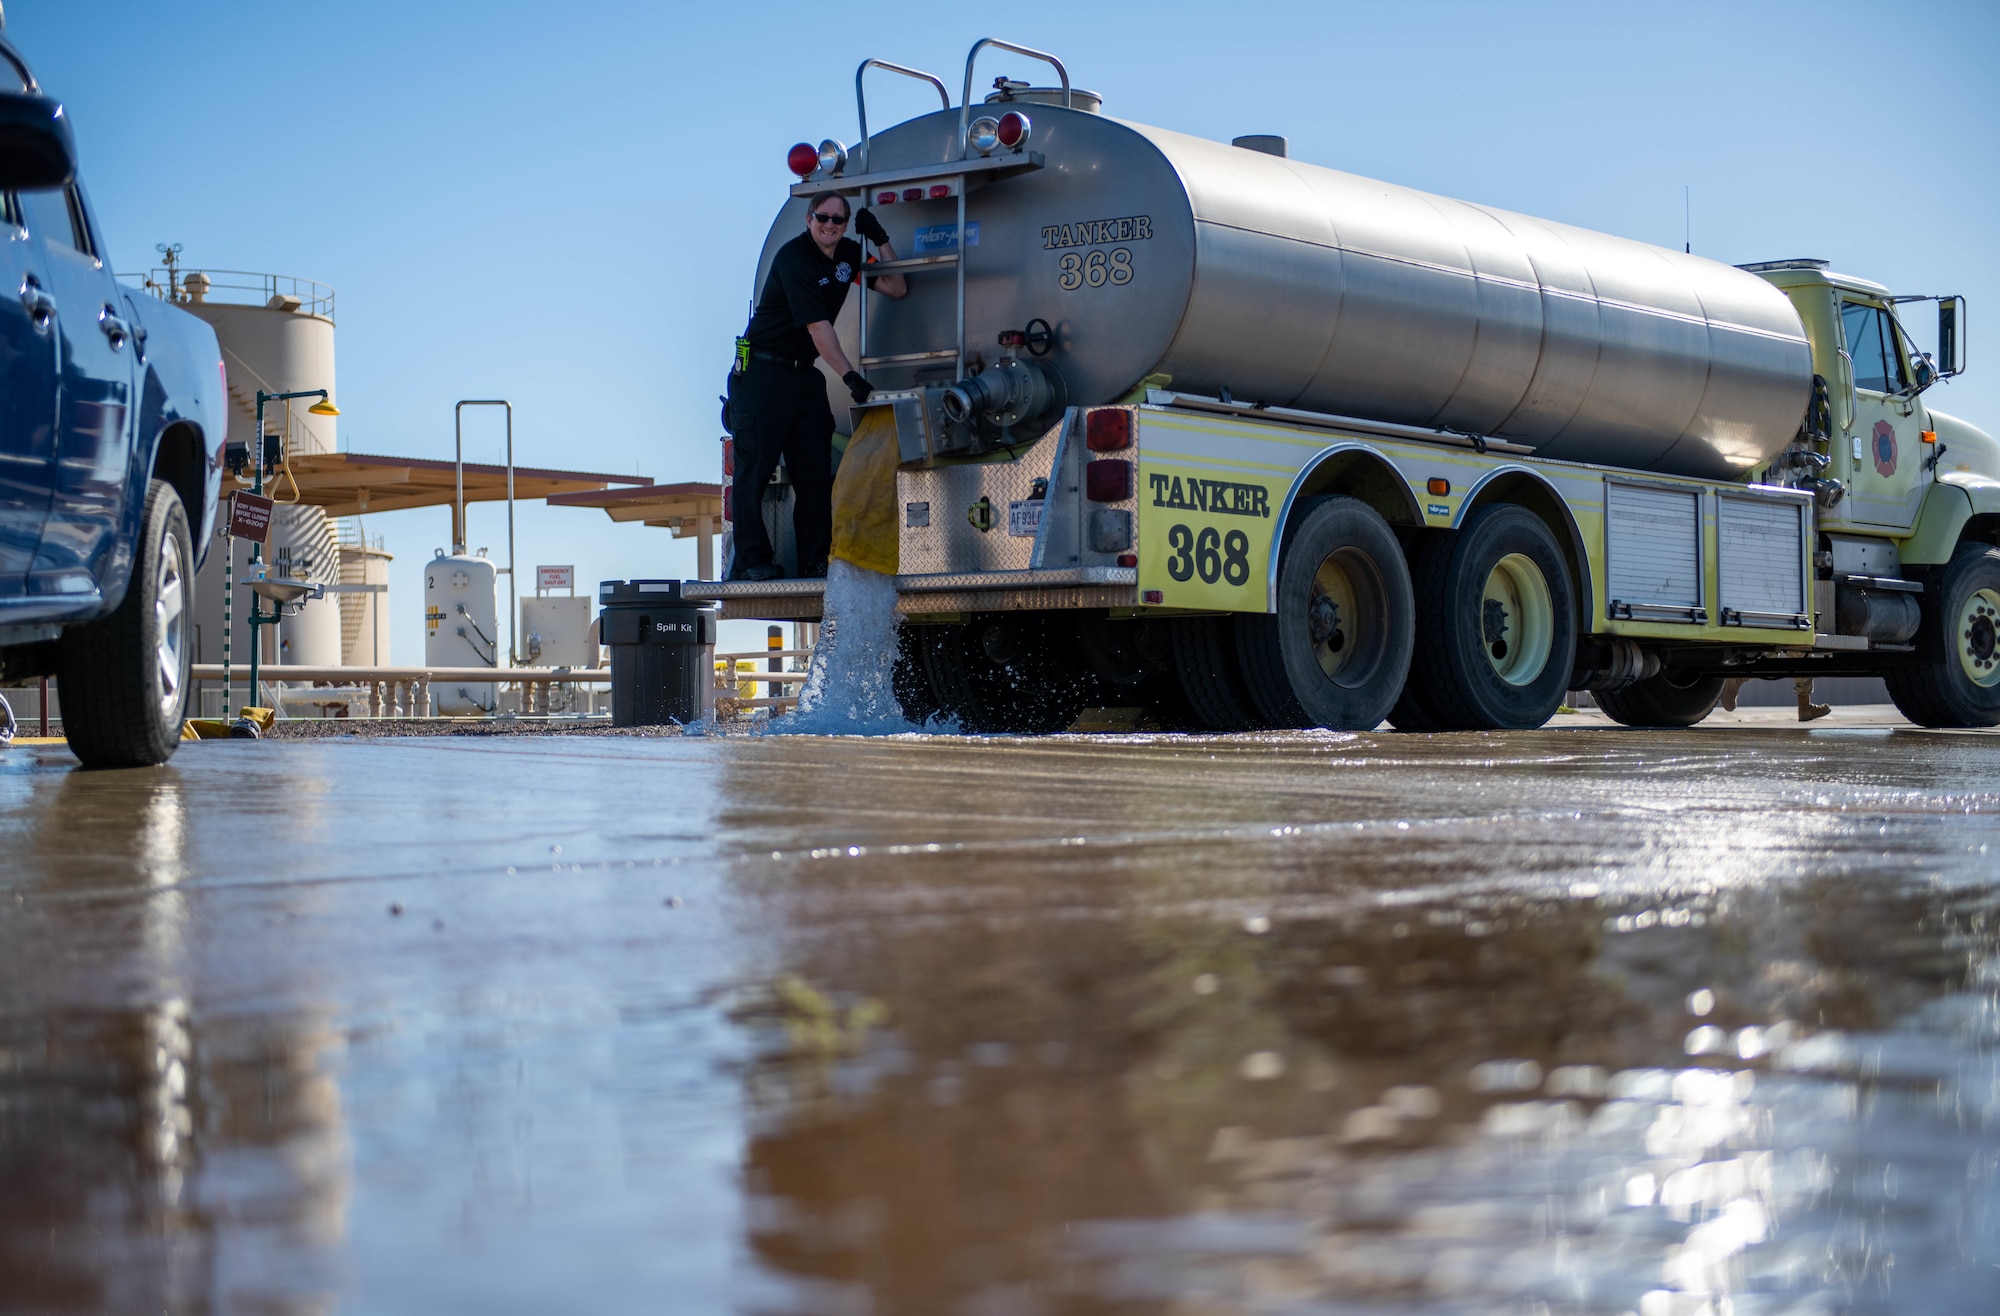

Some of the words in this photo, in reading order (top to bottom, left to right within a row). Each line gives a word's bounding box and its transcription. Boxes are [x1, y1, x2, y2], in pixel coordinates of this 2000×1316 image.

[1042, 215, 1153, 250] TANKER
[1059, 247, 1134, 291] 368
[1150, 473, 1270, 518] TANKER
[235, 509, 251, 518] BEFORE
[251, 513, 269, 522] CLOSING
[238, 517, 264, 528] X-6205
[1168, 524, 1250, 586] 368
[429, 576, 434, 589] 2
[656, 623, 676, 632] Spill
[681, 624, 692, 632] Kit
